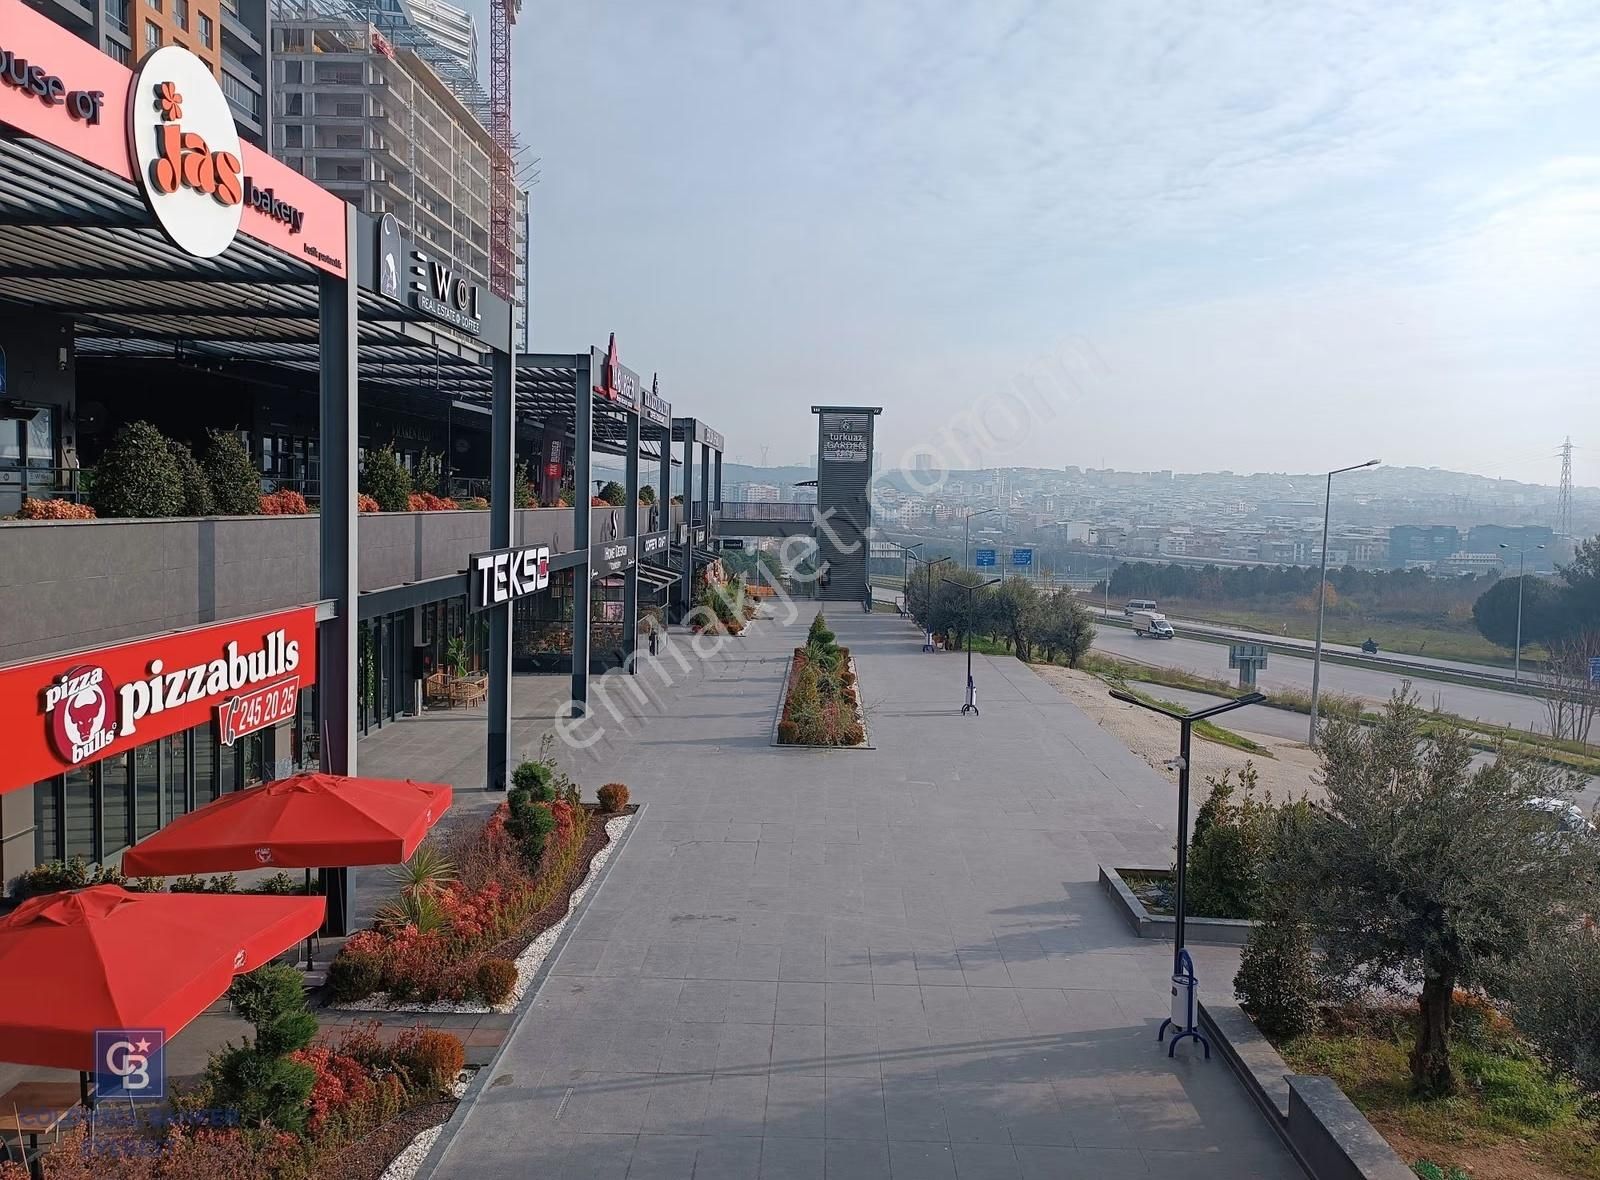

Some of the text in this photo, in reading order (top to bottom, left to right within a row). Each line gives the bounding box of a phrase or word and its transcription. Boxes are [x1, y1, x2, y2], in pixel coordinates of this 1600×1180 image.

[66, 91, 104, 127] of
[245, 178, 304, 234] bakery
[422, 296, 480, 333] REAL ESTATE COFFEE
[830, 432, 863, 442] turkuaz
[46, 667, 103, 713] pizza
[119, 628, 299, 737] pizzabulls
[239, 685, 295, 731] 245 20 25
[72, 728, 115, 764] bulls
